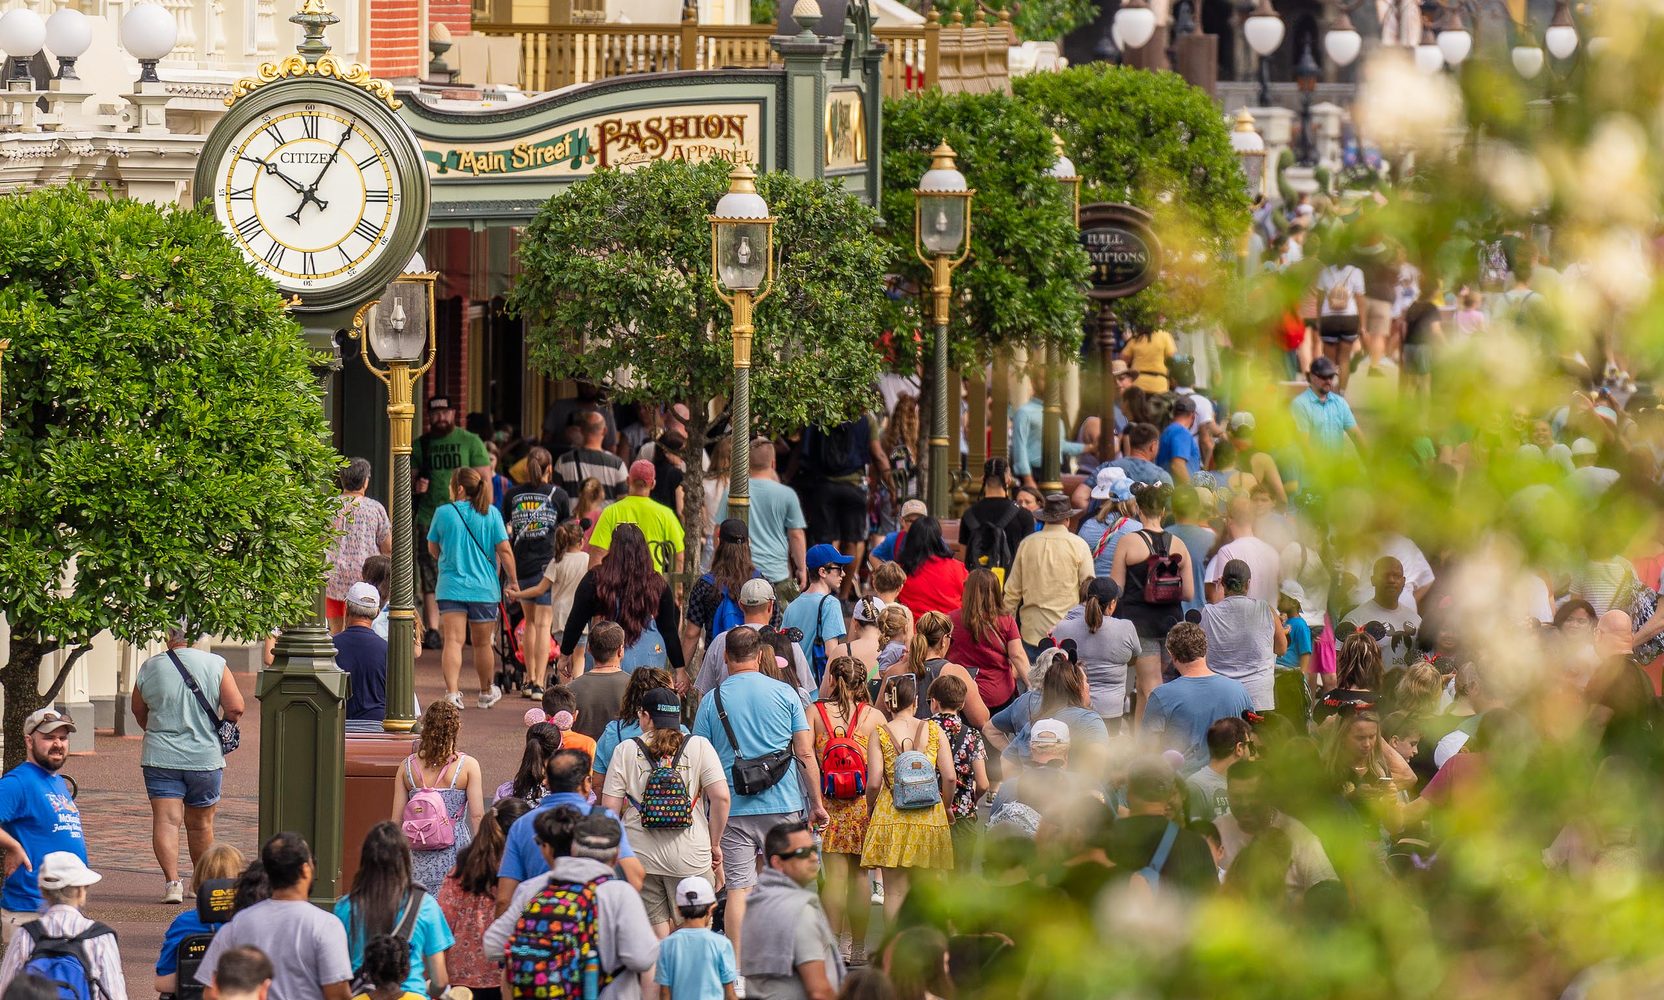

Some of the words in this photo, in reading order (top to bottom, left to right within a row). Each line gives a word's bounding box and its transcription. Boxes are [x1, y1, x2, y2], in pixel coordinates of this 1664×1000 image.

[587, 113, 748, 169] FASHION
[280, 152, 338, 165] CITIZEN
[456, 149, 507, 176] Main
[511, 133, 572, 169] Street
[670, 144, 753, 164] APPAREL
[1087, 234, 1124, 244] HALL
[1091, 252, 1146, 263] MPIONS
